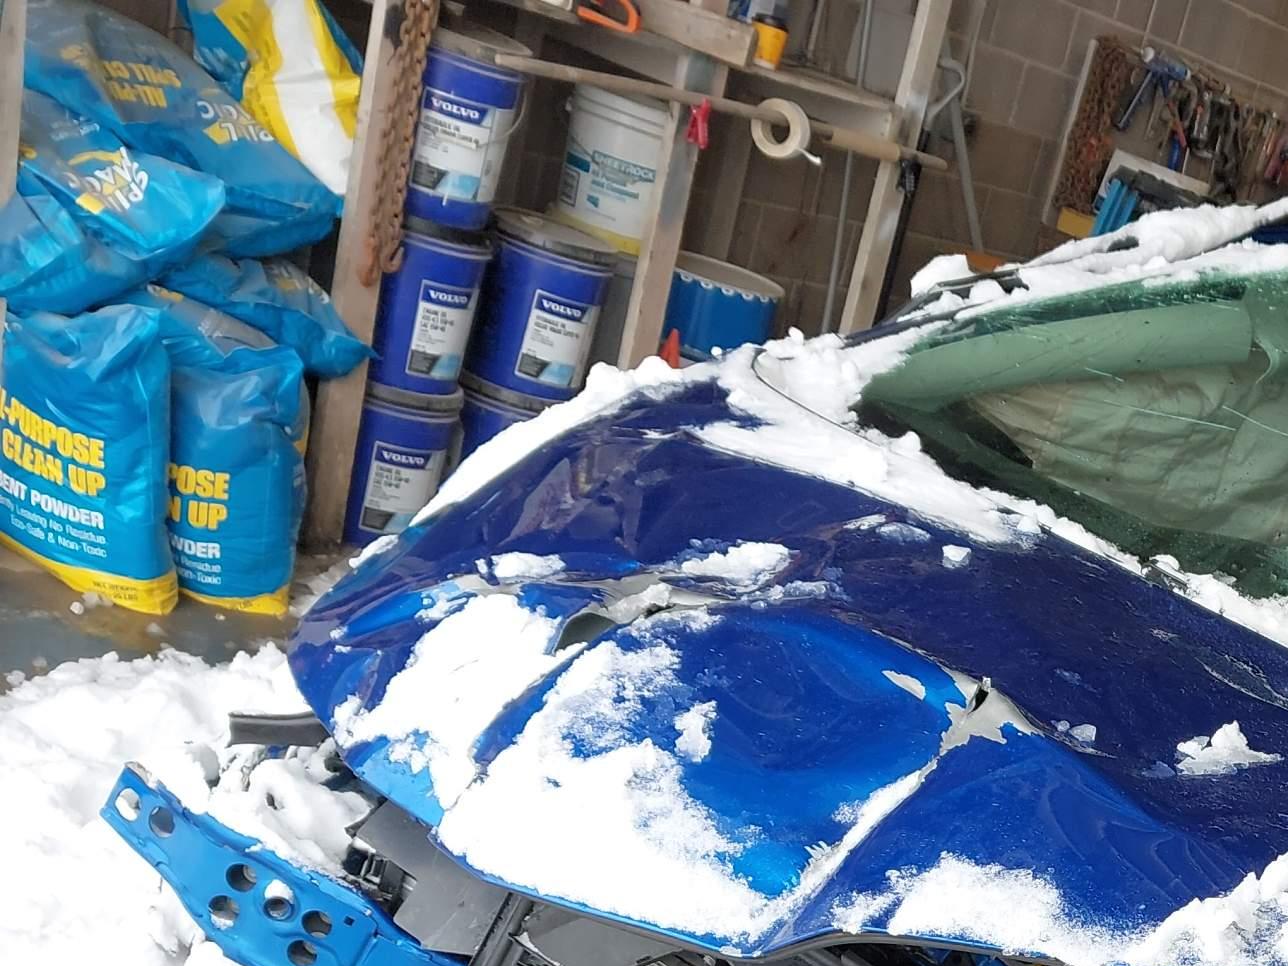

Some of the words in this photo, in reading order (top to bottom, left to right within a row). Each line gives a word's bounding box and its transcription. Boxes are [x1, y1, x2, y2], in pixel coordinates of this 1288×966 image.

[431, 97, 480, 119] VOLVO
[428, 289, 468, 304] VOLVO
[541, 299, 582, 318] VOLVO
[3, 428, 63, 486] CLEAN
[68, 464, 106, 496] UP
[382, 450, 425, 465] VOLVO
[31, 489, 105, 530] POWDER
[187, 500, 228, 531] UP
